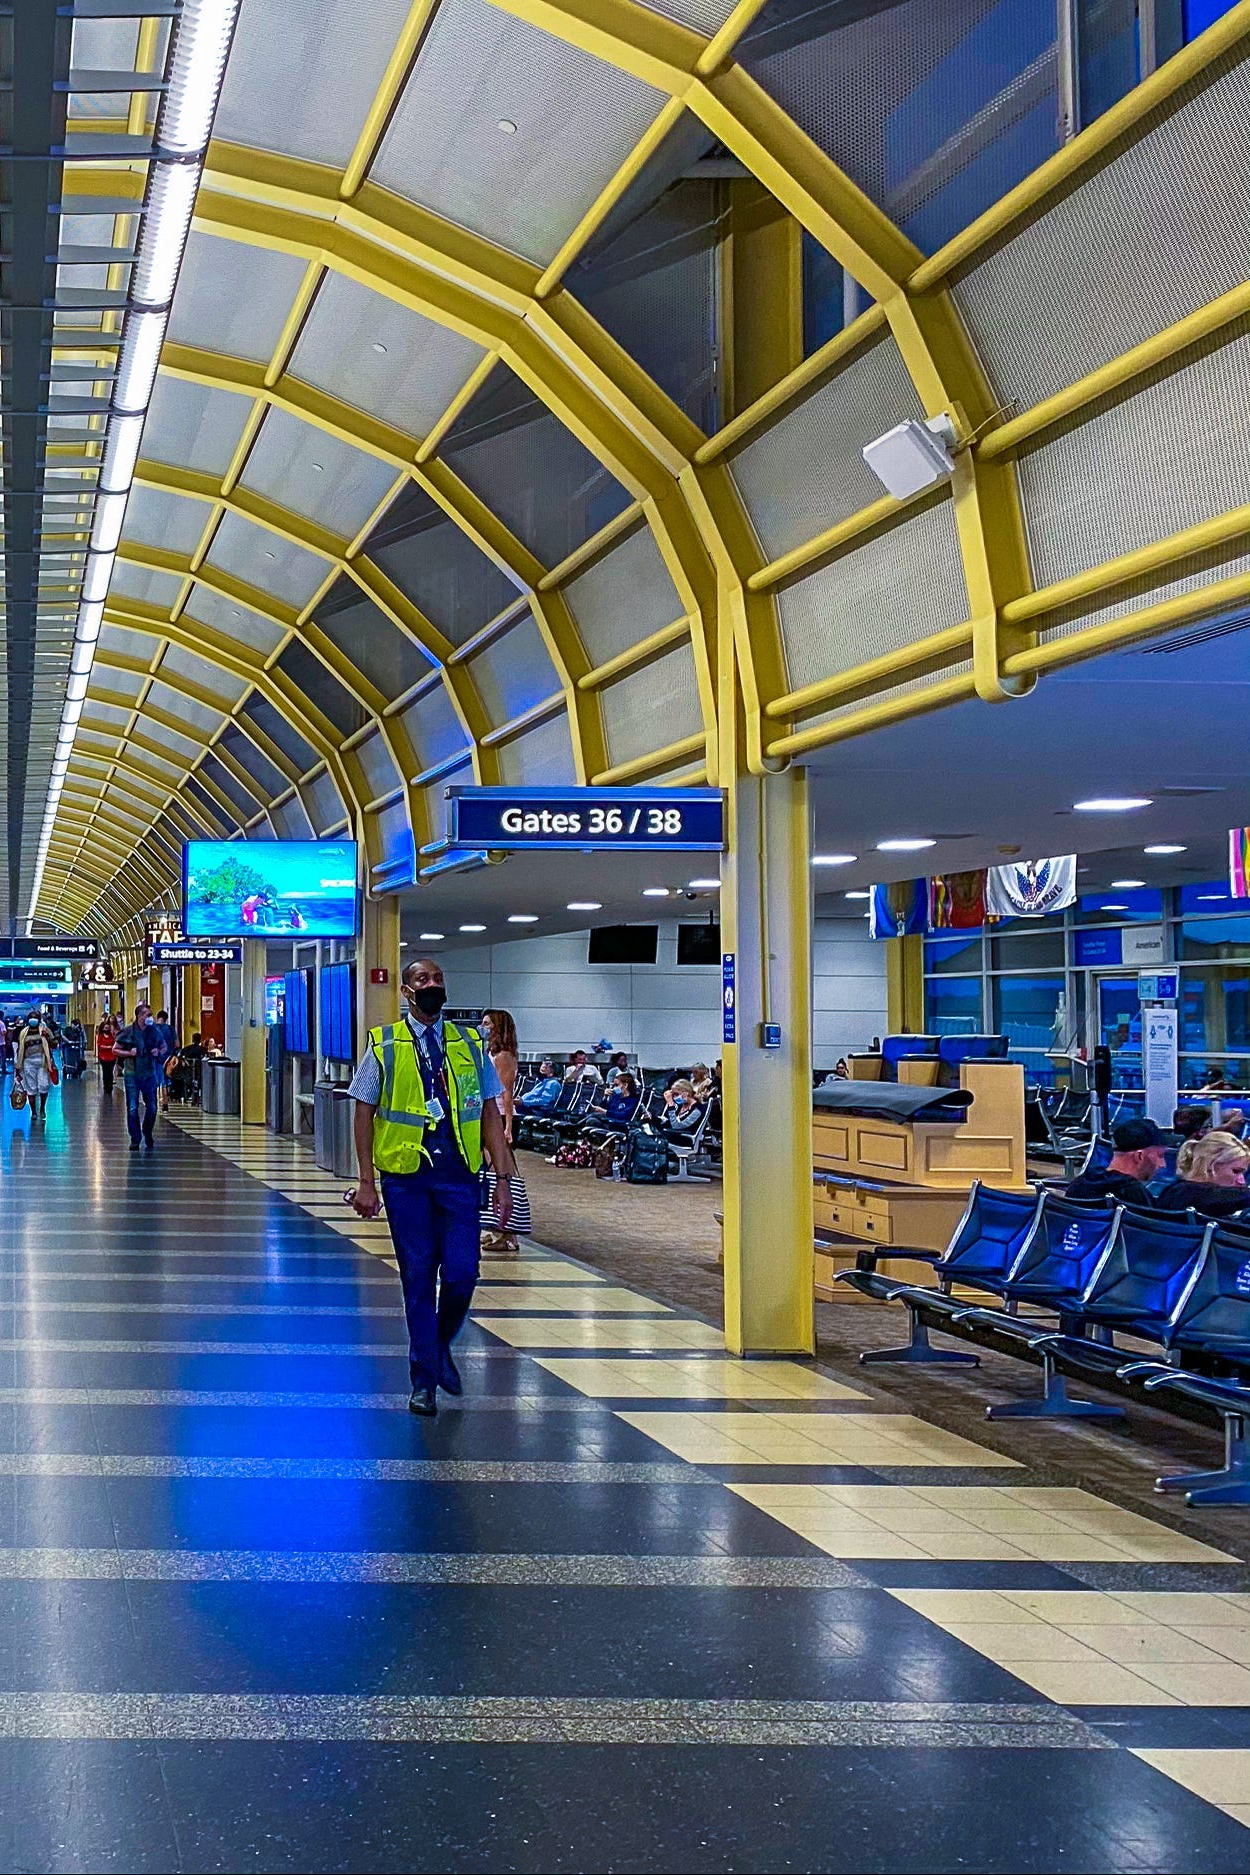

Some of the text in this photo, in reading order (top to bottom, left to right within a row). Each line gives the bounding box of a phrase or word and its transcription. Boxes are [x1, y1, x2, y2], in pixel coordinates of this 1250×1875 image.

[501, 807, 682, 834] Gates 36 / 38
[55, 944, 78, 952] Beverage
[160, 949, 194, 959] Shuttle
[195, 950, 207, 959] to
[207, 949, 234, 959] 23-34
